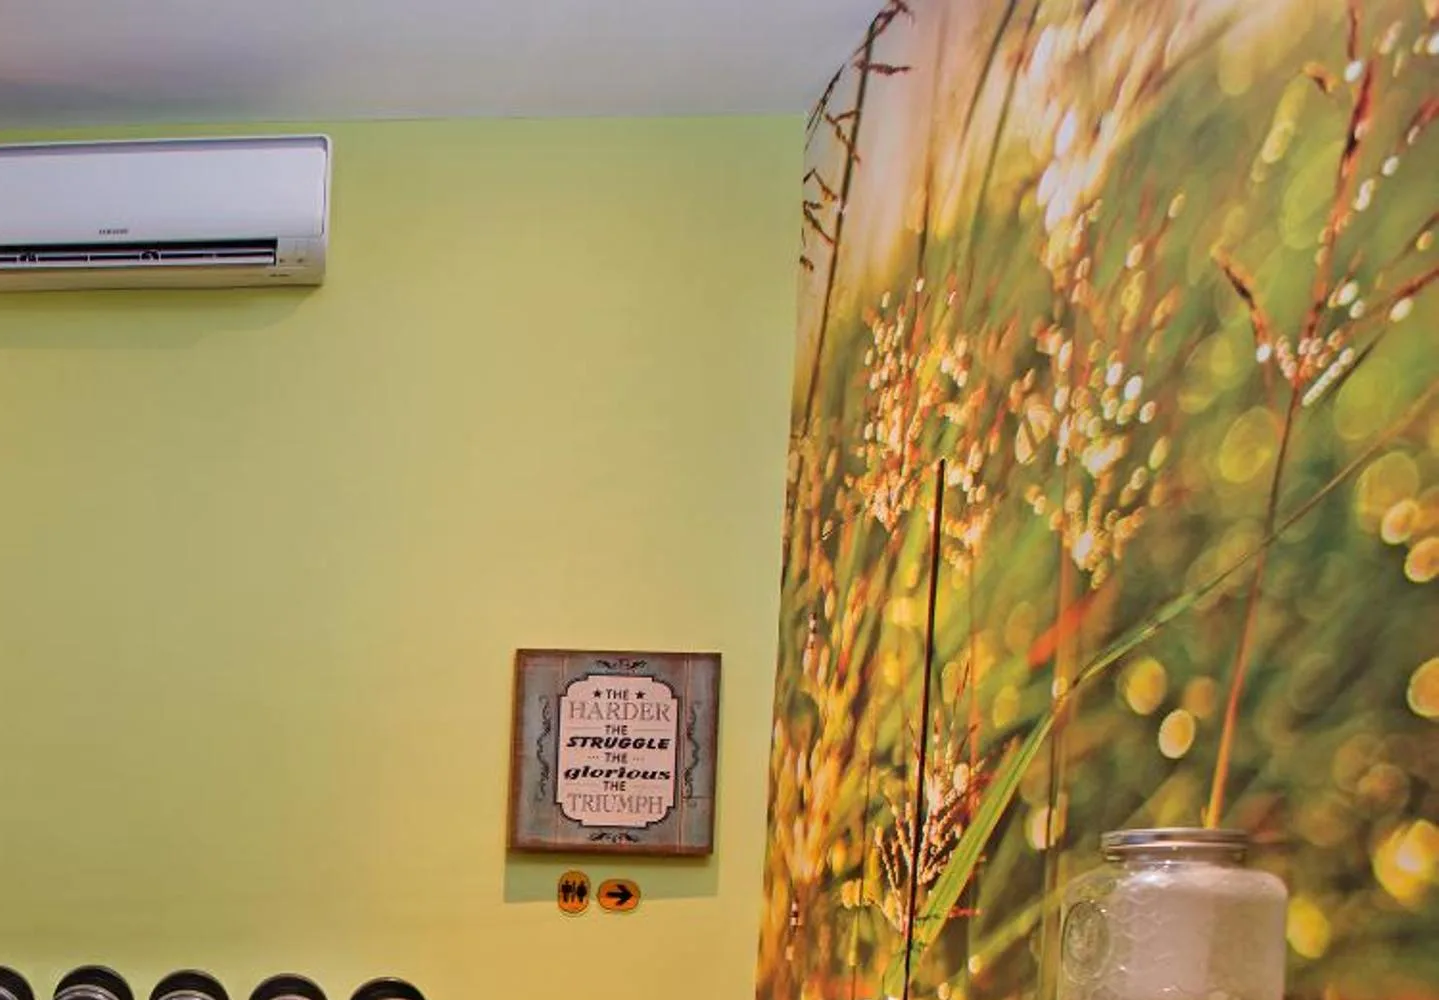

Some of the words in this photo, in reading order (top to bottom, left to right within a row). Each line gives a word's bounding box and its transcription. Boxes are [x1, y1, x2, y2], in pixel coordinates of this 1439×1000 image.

[605, 689, 629, 700] THE
[568, 701, 671, 722] HARDER
[604, 725, 628, 735] THE
[566, 736, 671, 750] STRUGGLE
[604, 753, 628, 764] THE
[563, 766, 670, 780] glorious
[602, 781, 626, 791] THE
[566, 793, 664, 814] TRIUMPH
